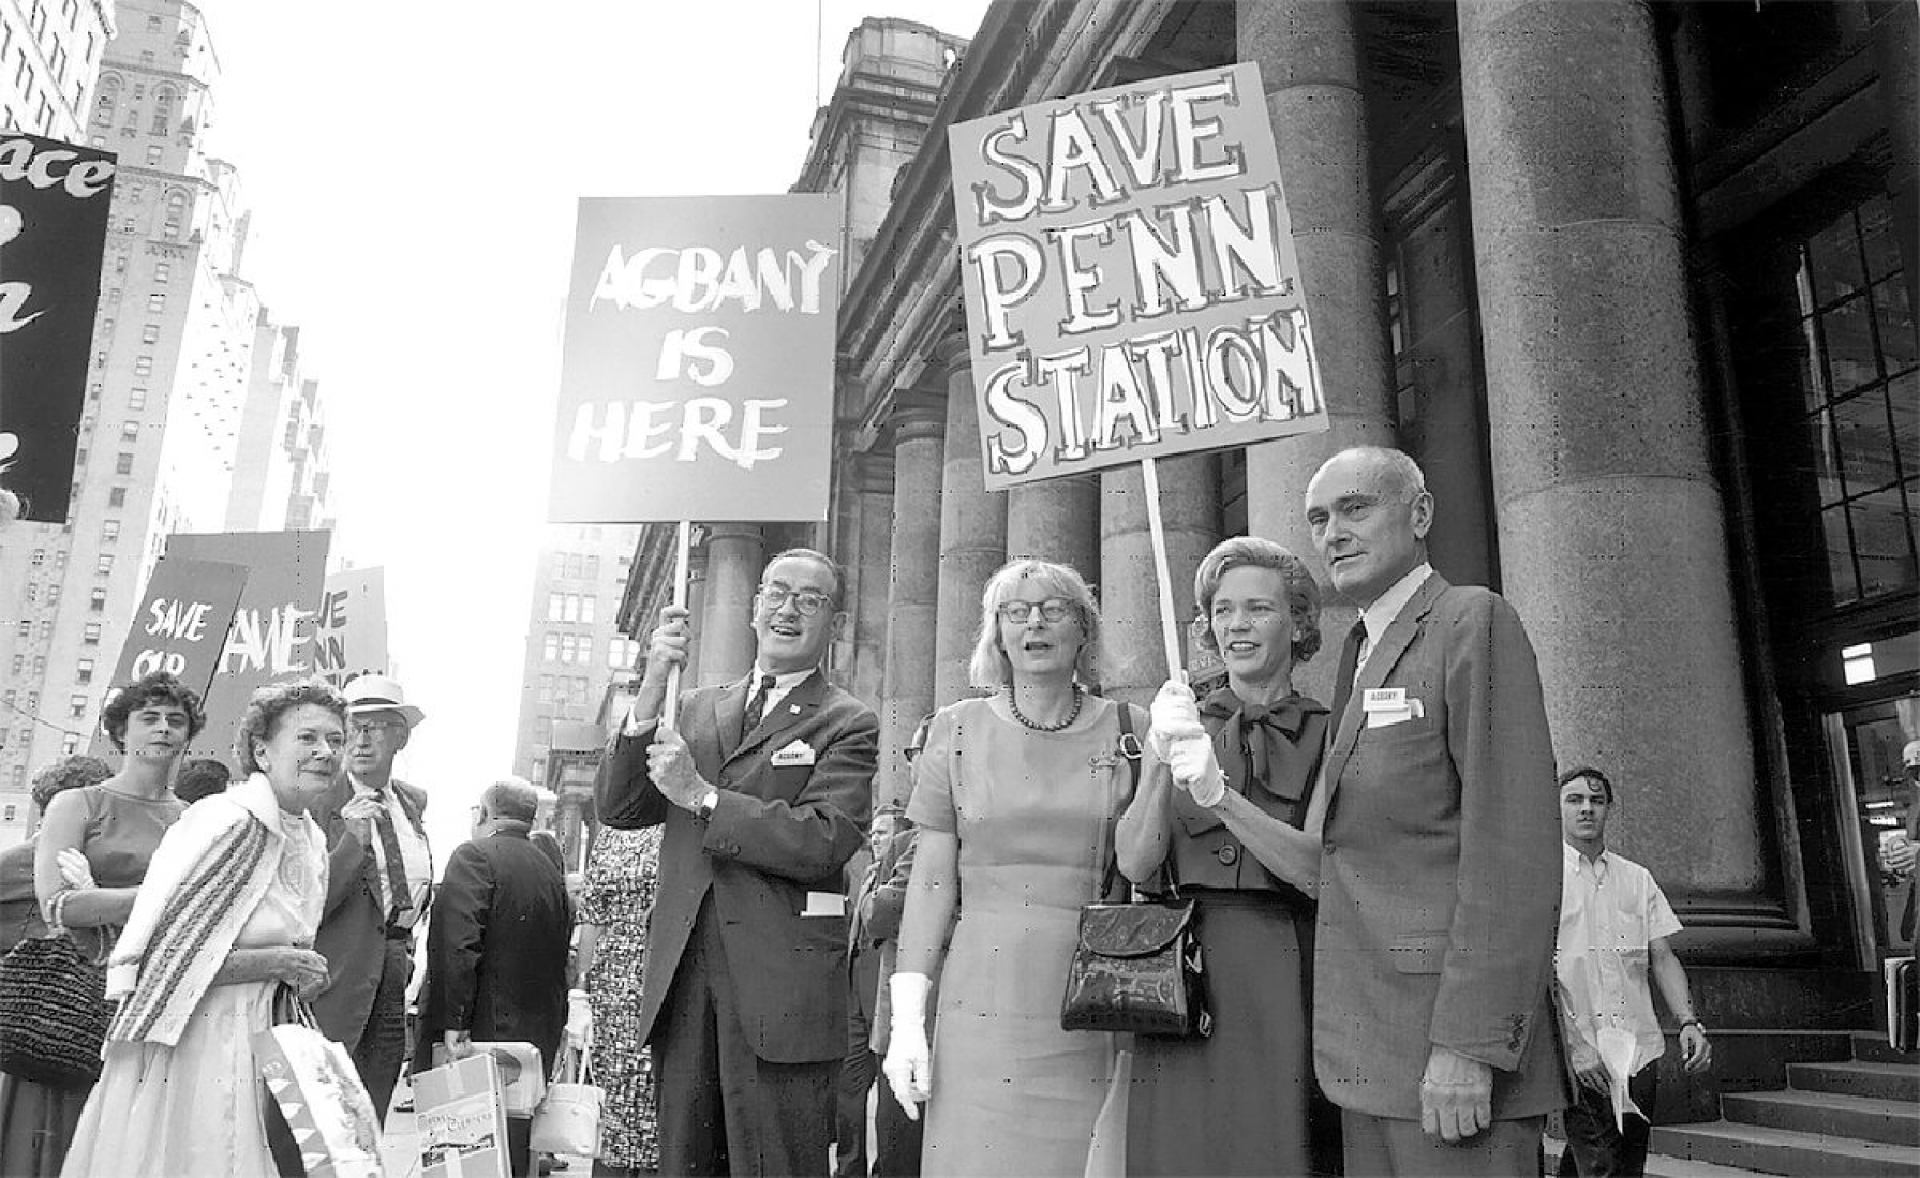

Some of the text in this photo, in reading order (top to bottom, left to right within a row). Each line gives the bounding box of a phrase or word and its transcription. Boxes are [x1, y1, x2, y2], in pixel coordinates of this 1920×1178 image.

[971, 72, 1247, 226] SAVE
[589, 239, 838, 314] AGBANY
[967, 181, 1293, 353] PENN
[653, 325, 734, 387] IS
[985, 308, 1322, 474] STATION
[567, 397, 790, 472] HERE
[145, 597, 213, 642] SAVE
